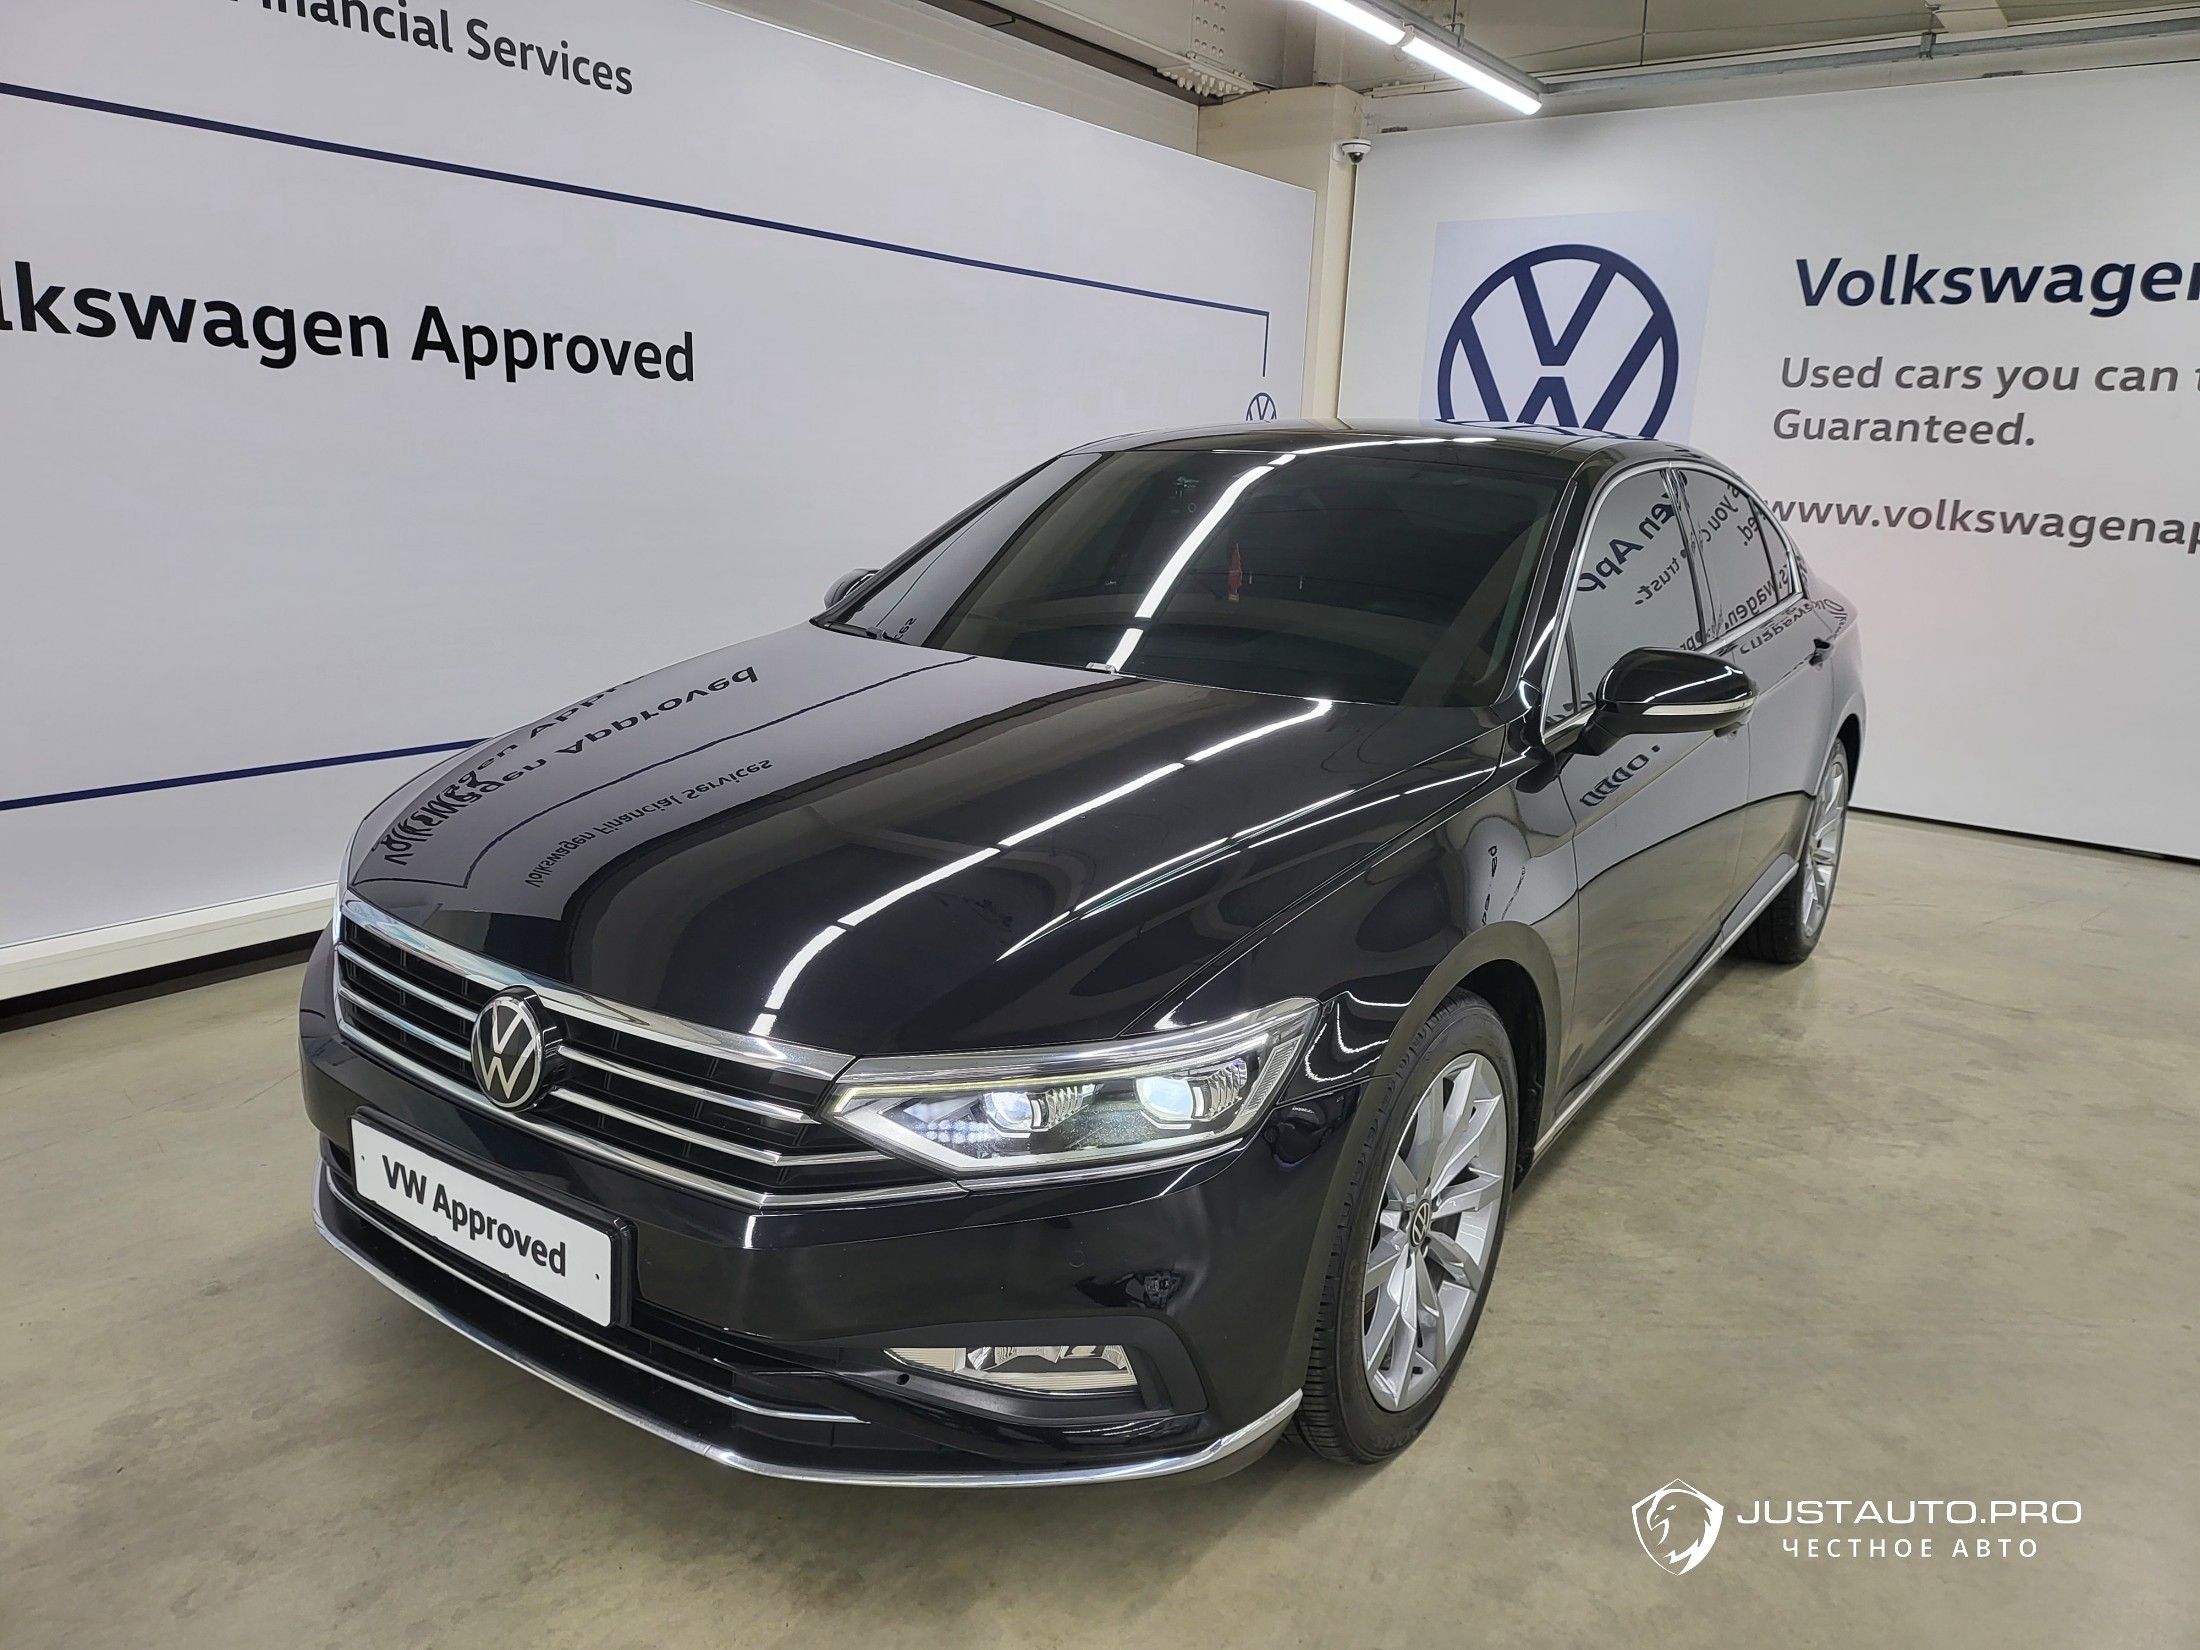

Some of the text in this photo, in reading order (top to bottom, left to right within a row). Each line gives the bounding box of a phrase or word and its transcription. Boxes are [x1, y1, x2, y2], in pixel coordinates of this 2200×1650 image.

[466, 18, 633, 95] Services
[0, 260, 695, 383] kswagen Approved
[1781, 356, 1884, 389] Used
[1895, 365, 1983, 390] cars
[1992, 365, 2080, 400] you
[2094, 366, 2179, 392] can
[1773, 408, 2035, 447] Guaranteed.
[381, 1154, 566, 1277] VW Approved
